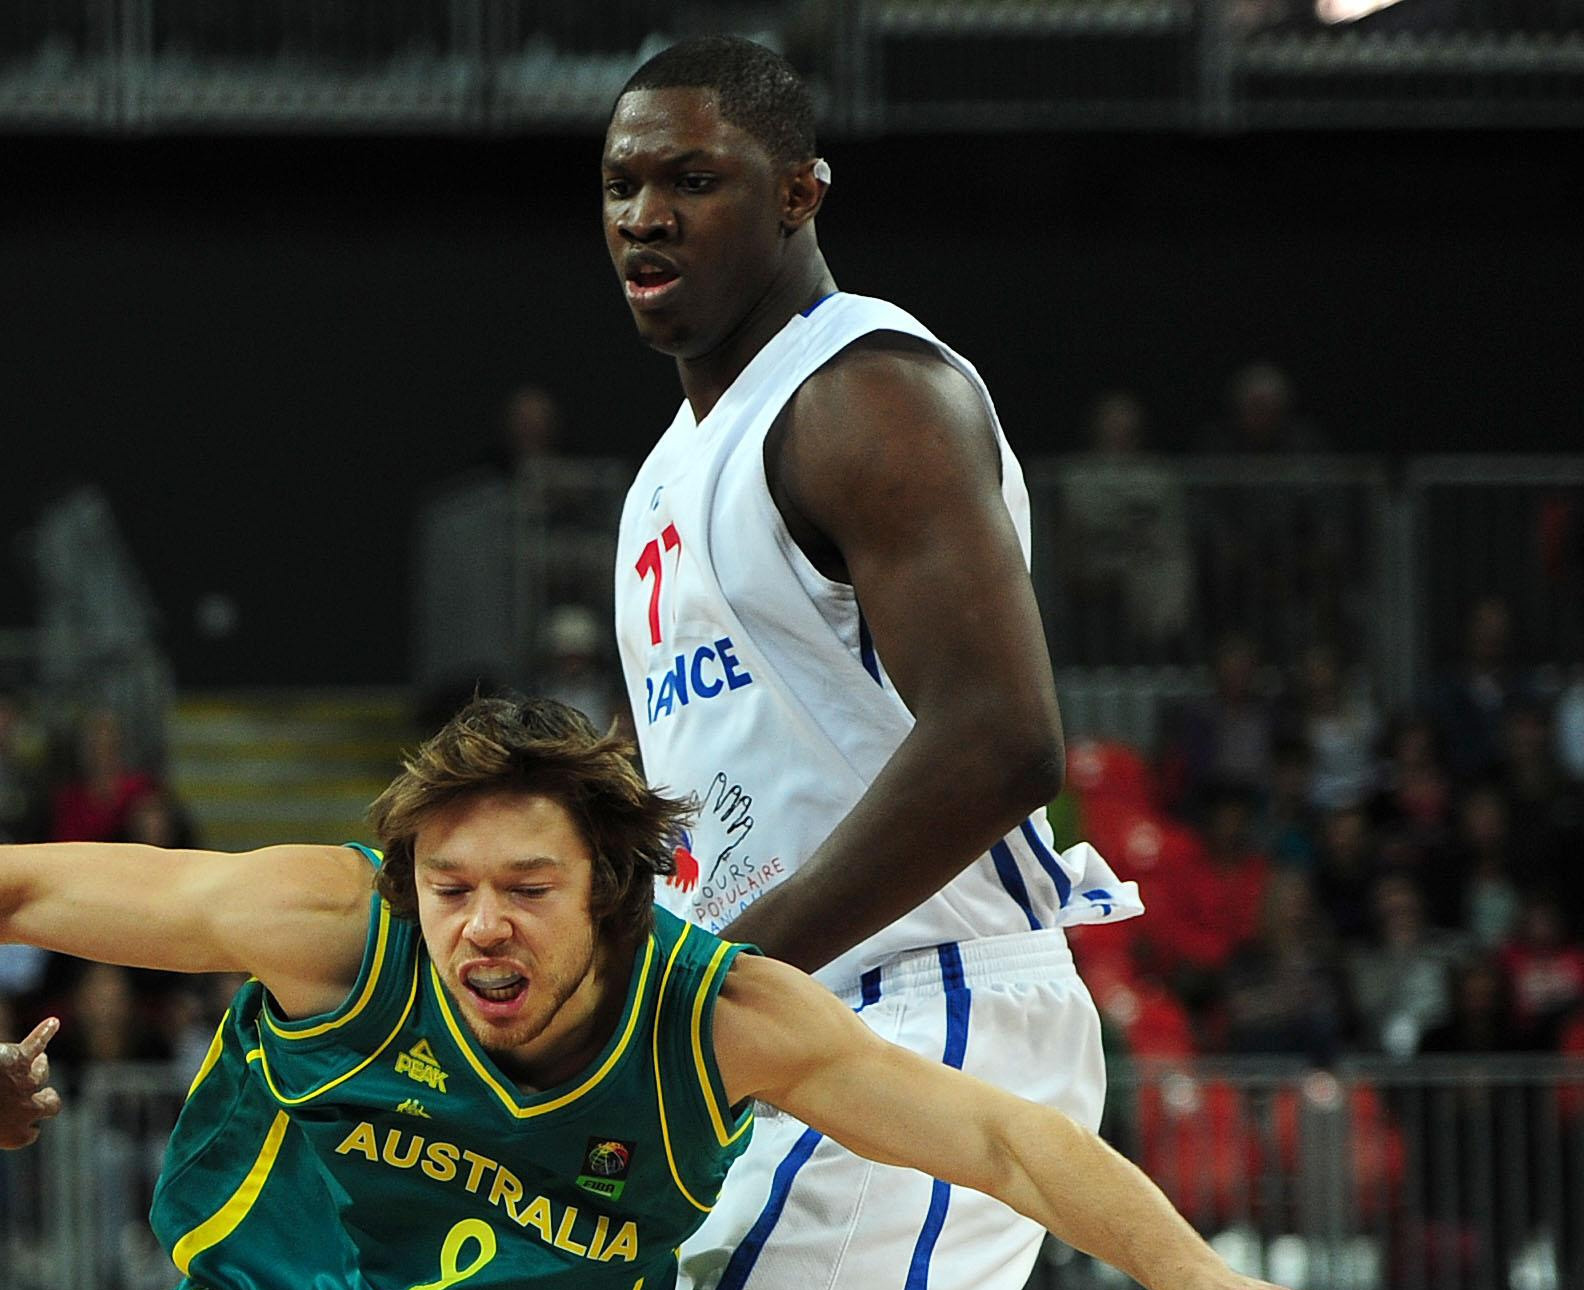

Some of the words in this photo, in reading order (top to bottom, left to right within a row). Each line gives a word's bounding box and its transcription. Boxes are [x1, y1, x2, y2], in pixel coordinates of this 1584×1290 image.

[646, 636, 753, 725] ANCE
[693, 856, 755, 906] OURS
[695, 857, 785, 923] POPULAIRE
[394, 1052, 449, 1094] PEAK
[335, 1121, 638, 1263] AUSTRALIA
